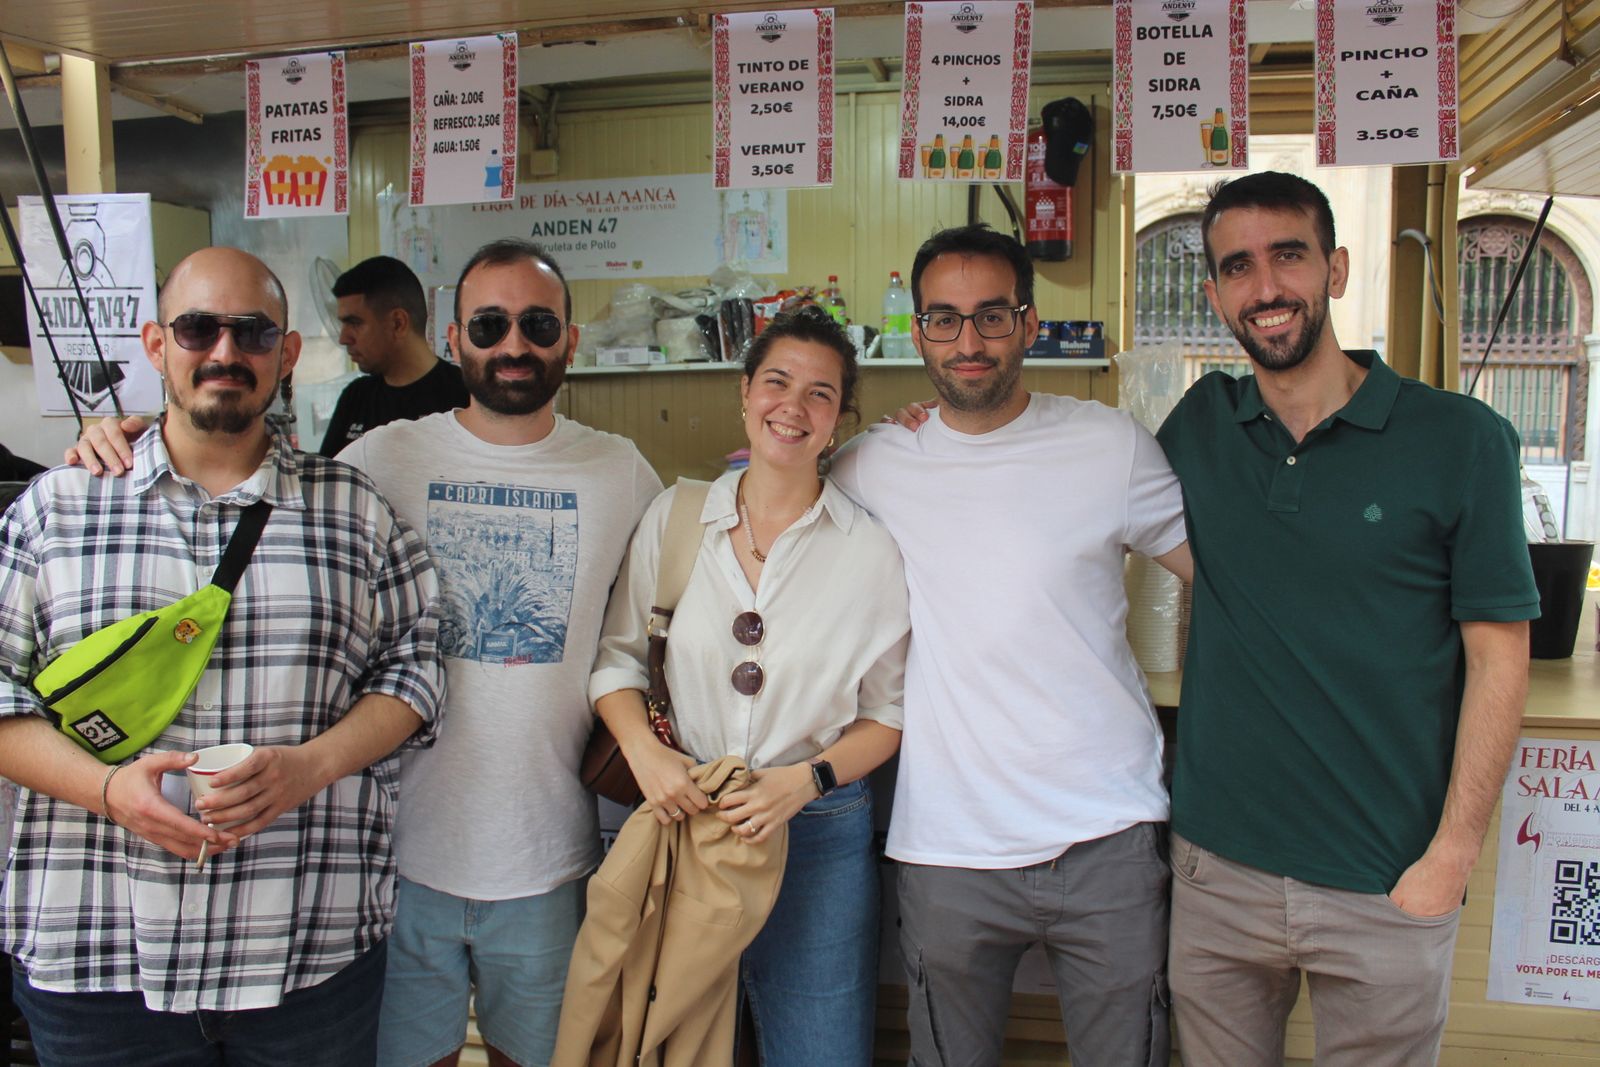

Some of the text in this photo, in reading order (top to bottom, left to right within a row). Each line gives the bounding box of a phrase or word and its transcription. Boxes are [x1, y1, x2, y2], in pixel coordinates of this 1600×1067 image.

[1136, 25, 1213, 40] BOTELLA
[931, 54, 1001, 66] 4 PINCHOS
[1163, 52, 1186, 66] DE
[1341, 47, 1428, 62] PINCHO
[737, 59, 809, 74] TINTO DE
[739, 81, 804, 95] VERANO
[1148, 78, 1200, 93] SIDRA
[1356, 85, 1419, 101] CAÑA
[433, 90, 484, 107] CAÑA: 2.00€
[944, 95, 983, 107] SIDRA
[265, 100, 328, 118] PATATAS
[750, 102, 793, 115] 2,50€
[1152, 104, 1198, 119] 7,50€
[433, 113, 501, 130] REFRESCO: 2,50€
[942, 116, 986, 128] 14,00€
[271, 127, 321, 144] FRITAS
[1356, 127, 1419, 141] 3.50€
[433, 138, 480, 155] AGUA: 1.50€
[741, 143, 806, 156] VERMUT
[751, 164, 794, 176] 3,50€
[520, 194, 538, 210] DE
[531, 218, 618, 237] ANDEN 47
[575, 240, 587, 251] de
[590, 239, 616, 251] Pollo
[444, 485, 564, 510] CAPRI ISLAND
[1563, 803, 1581, 813] DEL
[1584, 804, 1591, 813] 4
[1516, 964, 1543, 975] VOTA
[1546, 967, 1568, 977] POR
[1570, 969, 1584, 978] EL
